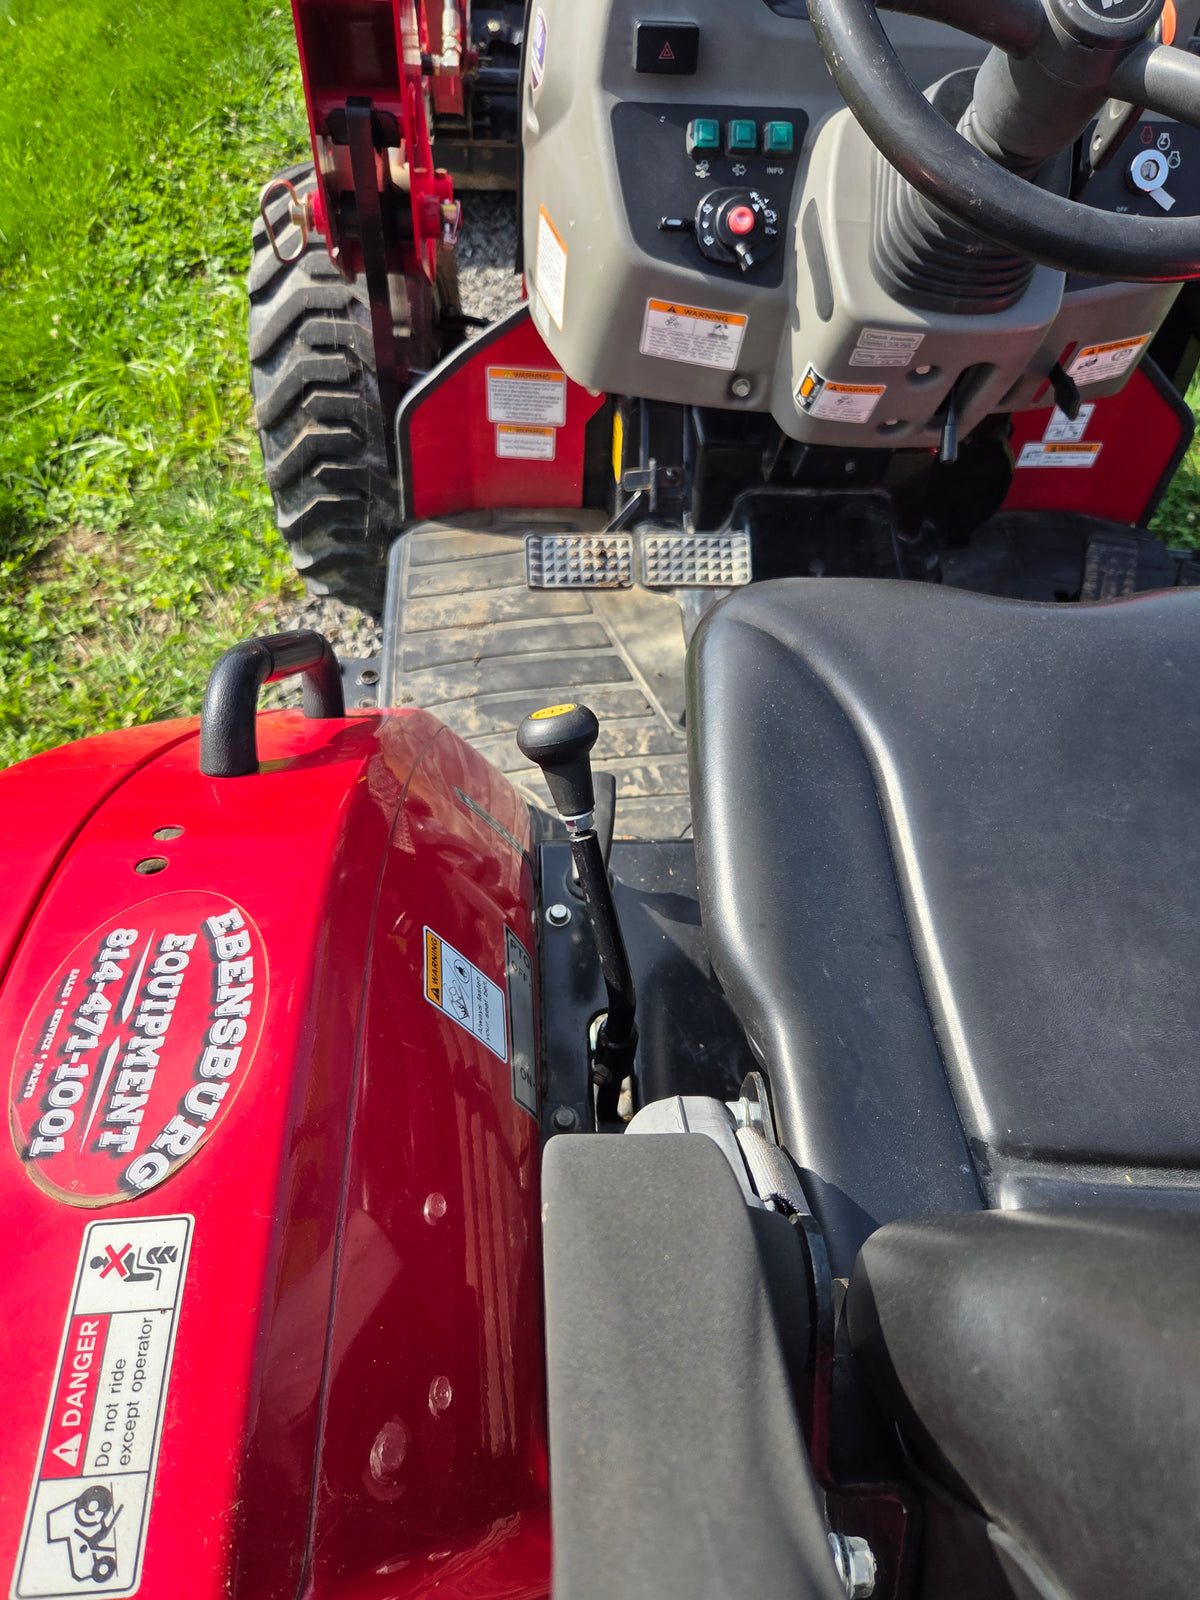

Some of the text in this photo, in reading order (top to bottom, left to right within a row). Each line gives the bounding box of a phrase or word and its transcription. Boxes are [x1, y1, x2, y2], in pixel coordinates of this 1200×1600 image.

[766, 166, 784, 175] INFO
[683, 308, 729, 323] WARNING
[839, 385, 882, 393] WARNING
[431, 937, 439, 985] WARNING
[510, 939, 530, 969] PTO
[511, 960, 528, 982] OFF
[23, 968, 80, 1098] SALES SERVICE PARTS
[29, 928, 138, 1157] 814-471-1001
[98, 932, 198, 1154] EQUIPMENT
[125, 907, 253, 1190] EBENSBURG
[520, 1066, 532, 1088] ON
[61, 1320, 99, 1427] DANGER
[119, 1317, 153, 1466] except operator
[94, 1358, 126, 1467] Do not ride
